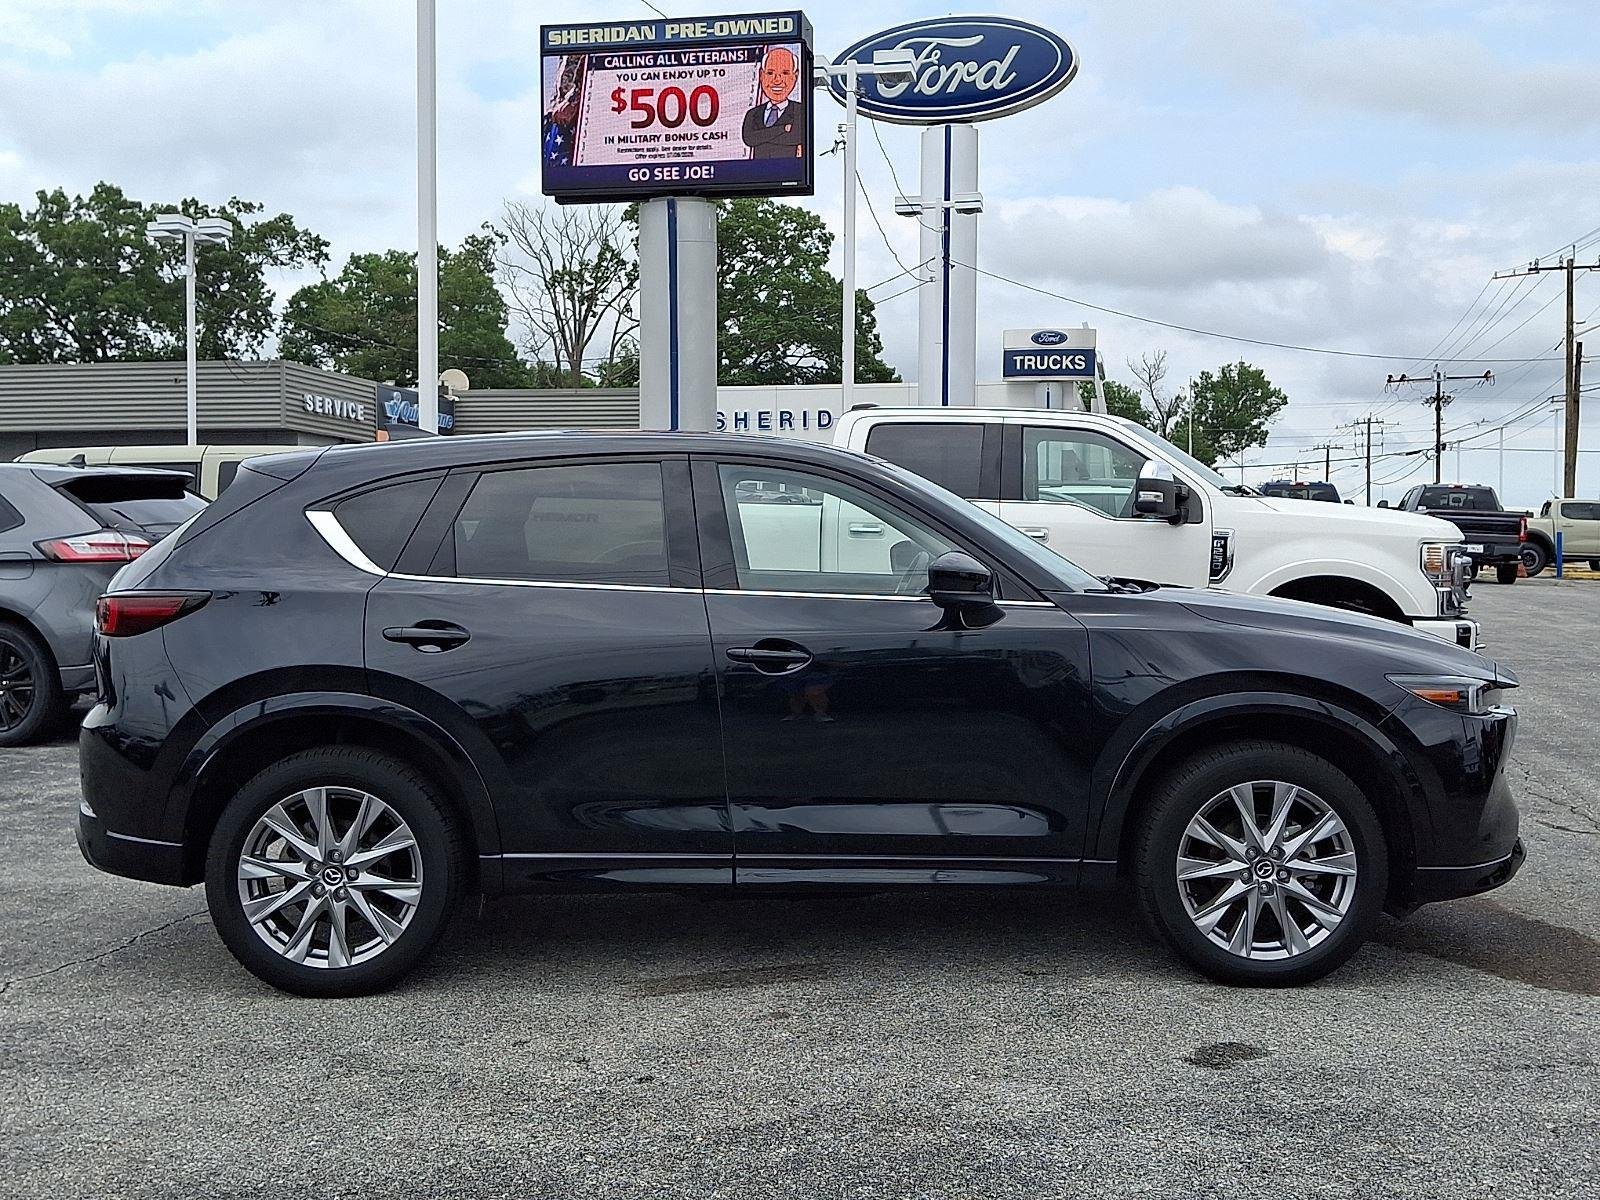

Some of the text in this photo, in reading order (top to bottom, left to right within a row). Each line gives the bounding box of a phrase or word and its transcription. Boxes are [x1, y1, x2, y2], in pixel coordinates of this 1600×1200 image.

[548, 17, 794, 46] SHERIDAN PRE-OWNED
[604, 50, 748, 67] CALLING ALL VETERANS!
[876, 34, 1021, 98] Ford
[616, 68, 726, 82] YOU CAN ENJOY UP TO
[611, 85, 720, 130] $500
[604, 131, 728, 144] IN MILITARY BONUS CASH
[628, 165, 715, 181] GO SEE JOE!
[1038, 332, 1061, 343] Ford
[1012, 355, 1086, 370] TRUCKS
[305, 394, 364, 421] SERVICE
[716, 409, 833, 431] SHERID
